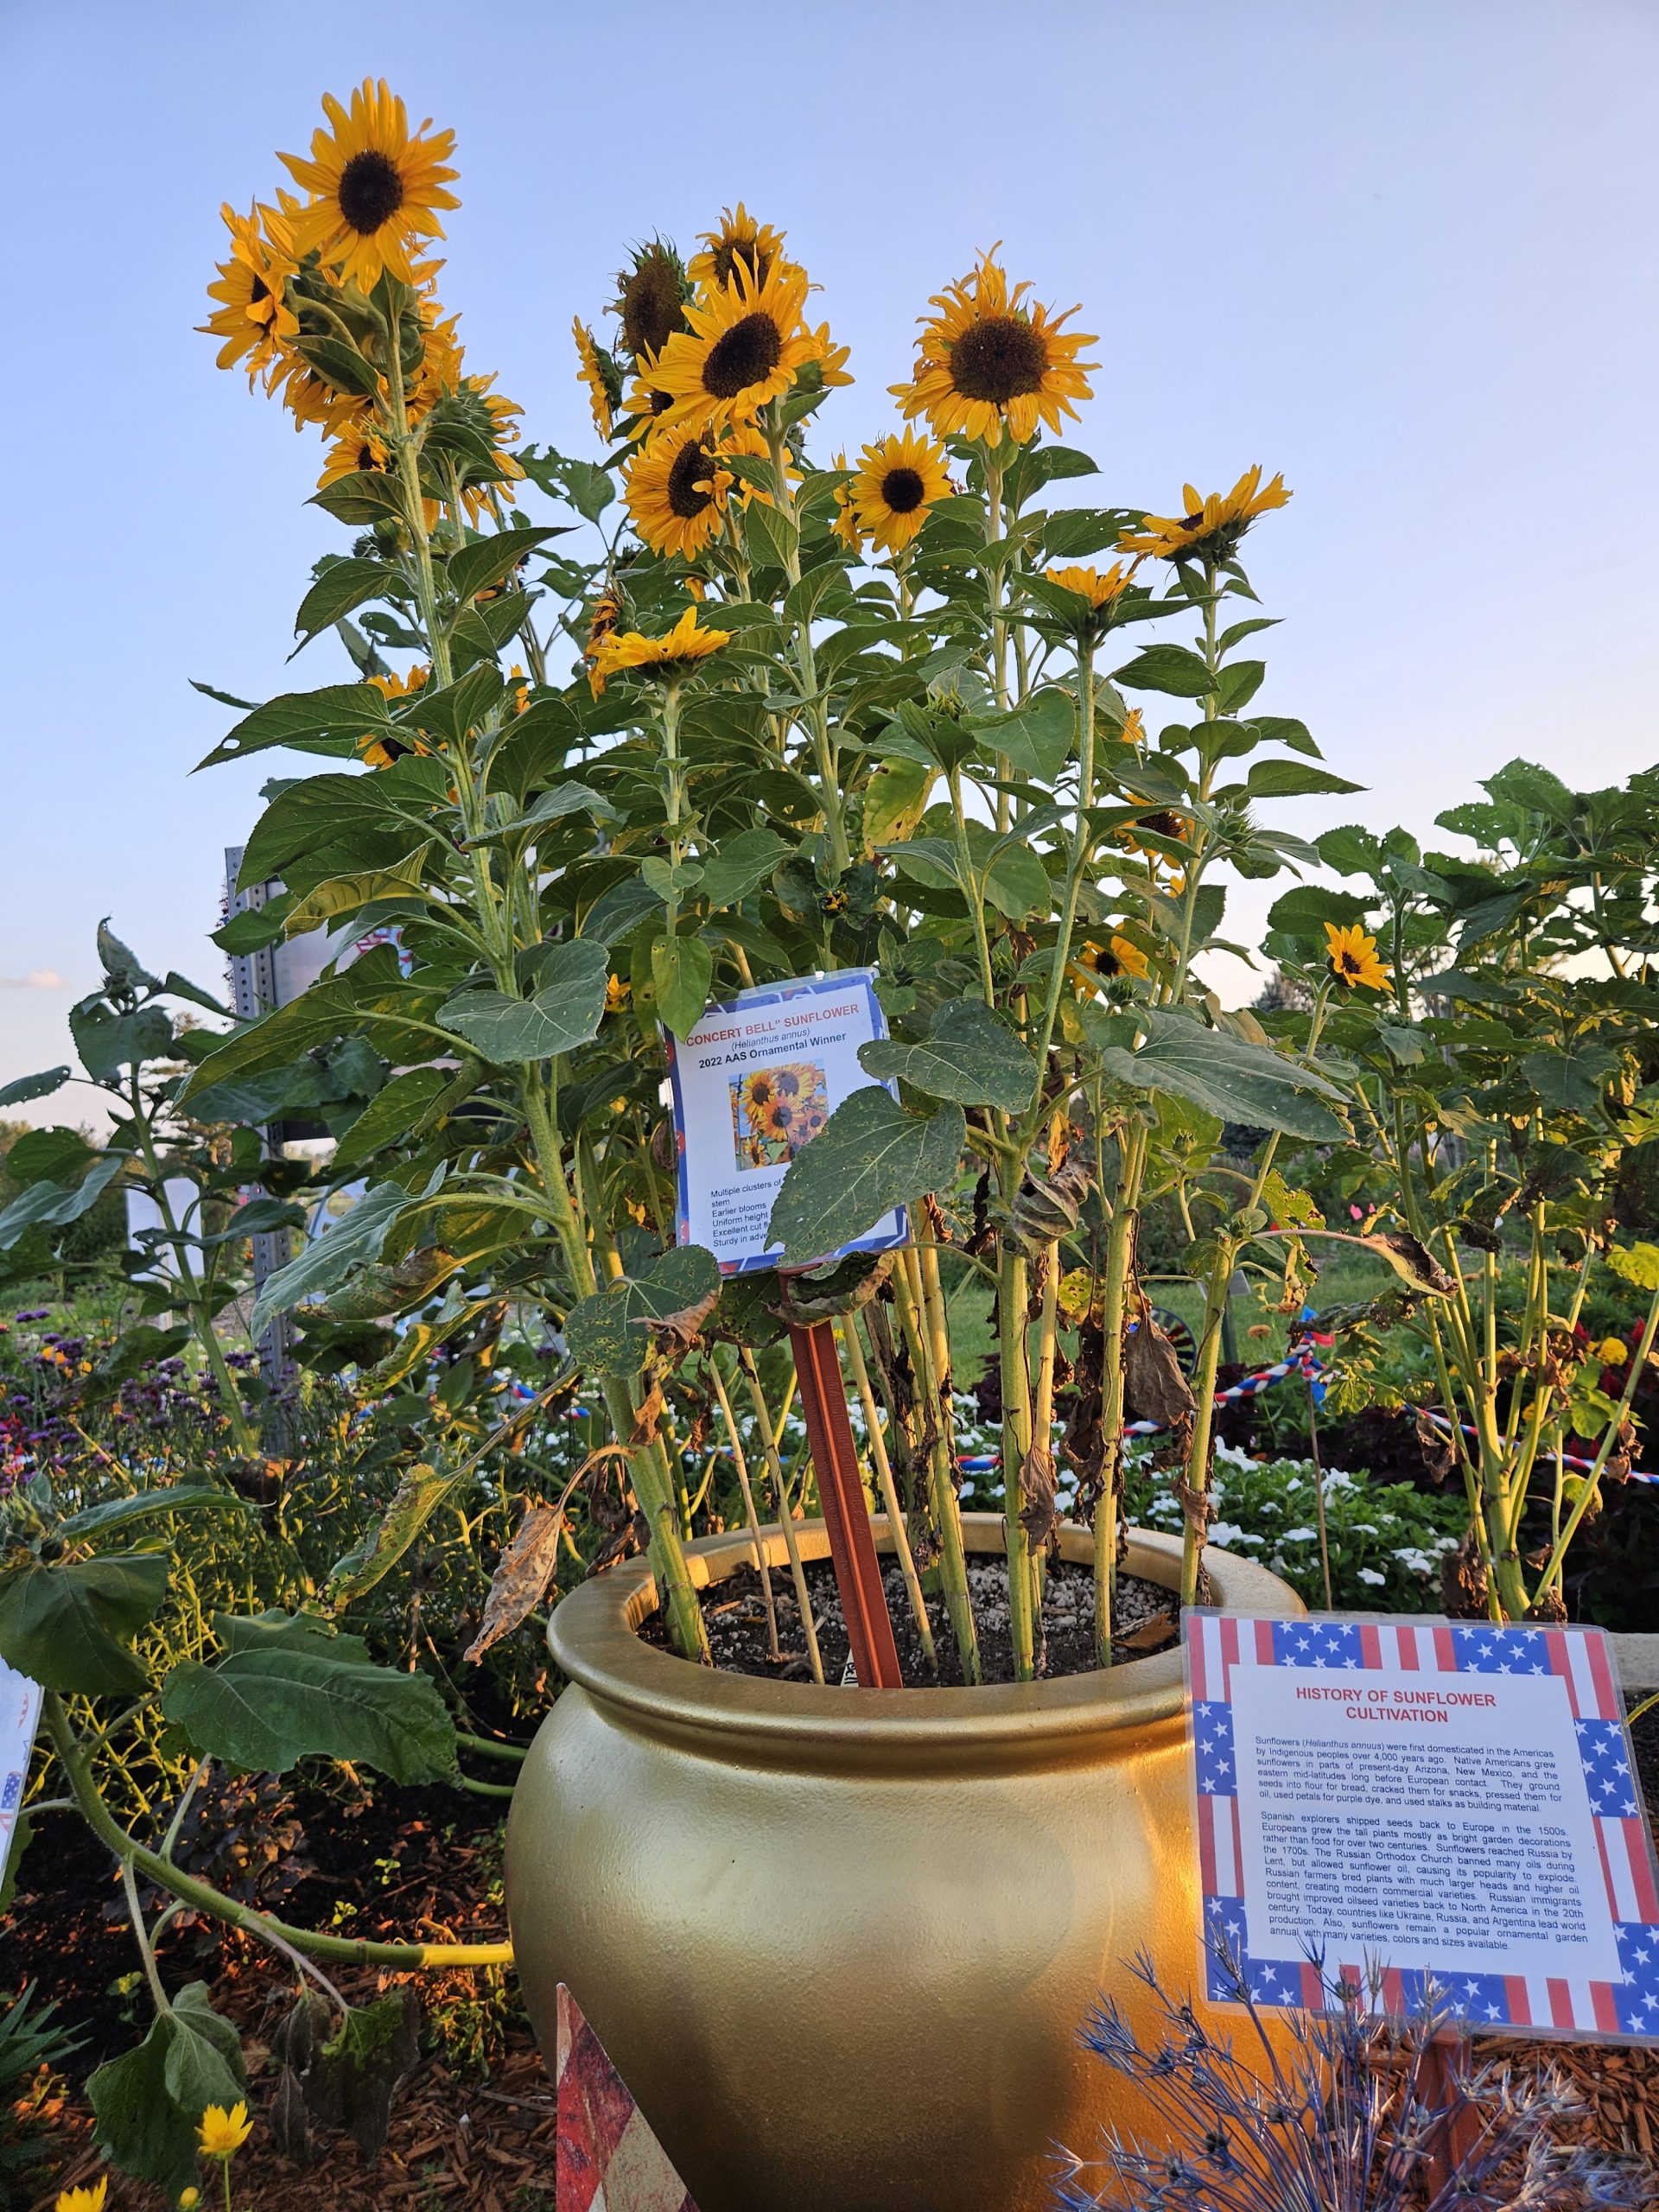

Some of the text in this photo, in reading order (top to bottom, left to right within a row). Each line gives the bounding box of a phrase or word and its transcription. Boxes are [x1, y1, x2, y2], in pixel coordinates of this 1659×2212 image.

[784, 1004, 859, 1027] SUNFLOWER
[699, 1033, 846, 1069] 2022 AAS Ornamental Winner
[732, 1027, 810, 1052] (Helianthus annus)
[711, 1187, 741, 1198] Multiple
[742, 1181, 772, 1192] clusters
[711, 1199, 730, 1208] stem
[712, 1203, 766, 1217] Earlier blooms
[712, 1211, 768, 1227] Uniform height
[713, 1225, 748, 1237] Excellent
[713, 1237, 738, 1247] Sturdy
[750, 1233, 768, 1242] adve
[1297, 1687, 1497, 1705] HISTORY OF SUNFLOWER
[1346, 1707, 1448, 1720] CULTIVATION
[1255, 1737, 1300, 1746] Sunflowers
[1351, 1742, 1384, 1751] annuus)
[1426, 1744, 1485, 1755] domesticated
[1497, 1747, 1510, 1756] the
[1513, 1748, 1554, 1758] Americas
[1256, 1747, 1266, 1757] by
[1269, 1748, 1313, 1758] Indigenous
[1317, 1751, 1350, 1759] peoples
[1374, 1752, 1398, 1762] 4,000
[1454, 1756, 1481, 1765] Native
[1485, 1758, 1531, 1768] Americans
[1258, 1769, 1560, 1791] eastern mid-latitudes long before European contact. They ground
[1262, 1812, 1568, 1836] Spanish explorers shipped seeds back Europe the 1500s.
[1262, 1822, 1307, 1834] Europeans
[1311, 1825, 1332, 1835] grew
[1337, 1827, 1351, 1835] the
[1355, 1827, 1368, 1836] tall
[1372, 1828, 1399, 1838] plants
[1404, 1832, 1432, 1840] mostly
[1452, 1833, 1478, 1843] bright
[1482, 1835, 1514, 1845] garden
[1518, 1837, 1571, 1847] decorations
[1263, 1834, 1572, 1859] rather than food for over two centuries. Sunflowers reached Russia by
[1263, 1845, 1575, 1872] the 1700s. The Russian Orthodox Church banned many oils during
[1265, 1856, 1577, 1883] Lent, but allowed sunflower oil, causing its popularity explode.
[1266, 1867, 1580, 1894] Russian farmers bred plants with much larger heads and higher oil
[1267, 1880, 1582, 1906] content, creating modern commercial varieties. Russian immigrants
[1268, 1891, 1584, 1918] brought improved oilseed varieties back North America the 20th
[1268, 1903, 1586, 1930] century. Today, countries like Ukraine, Russia, and Argentina lead world
[1269, 1915, 1588, 1942] production. Also, sunflowers remain popular ornamental garden
